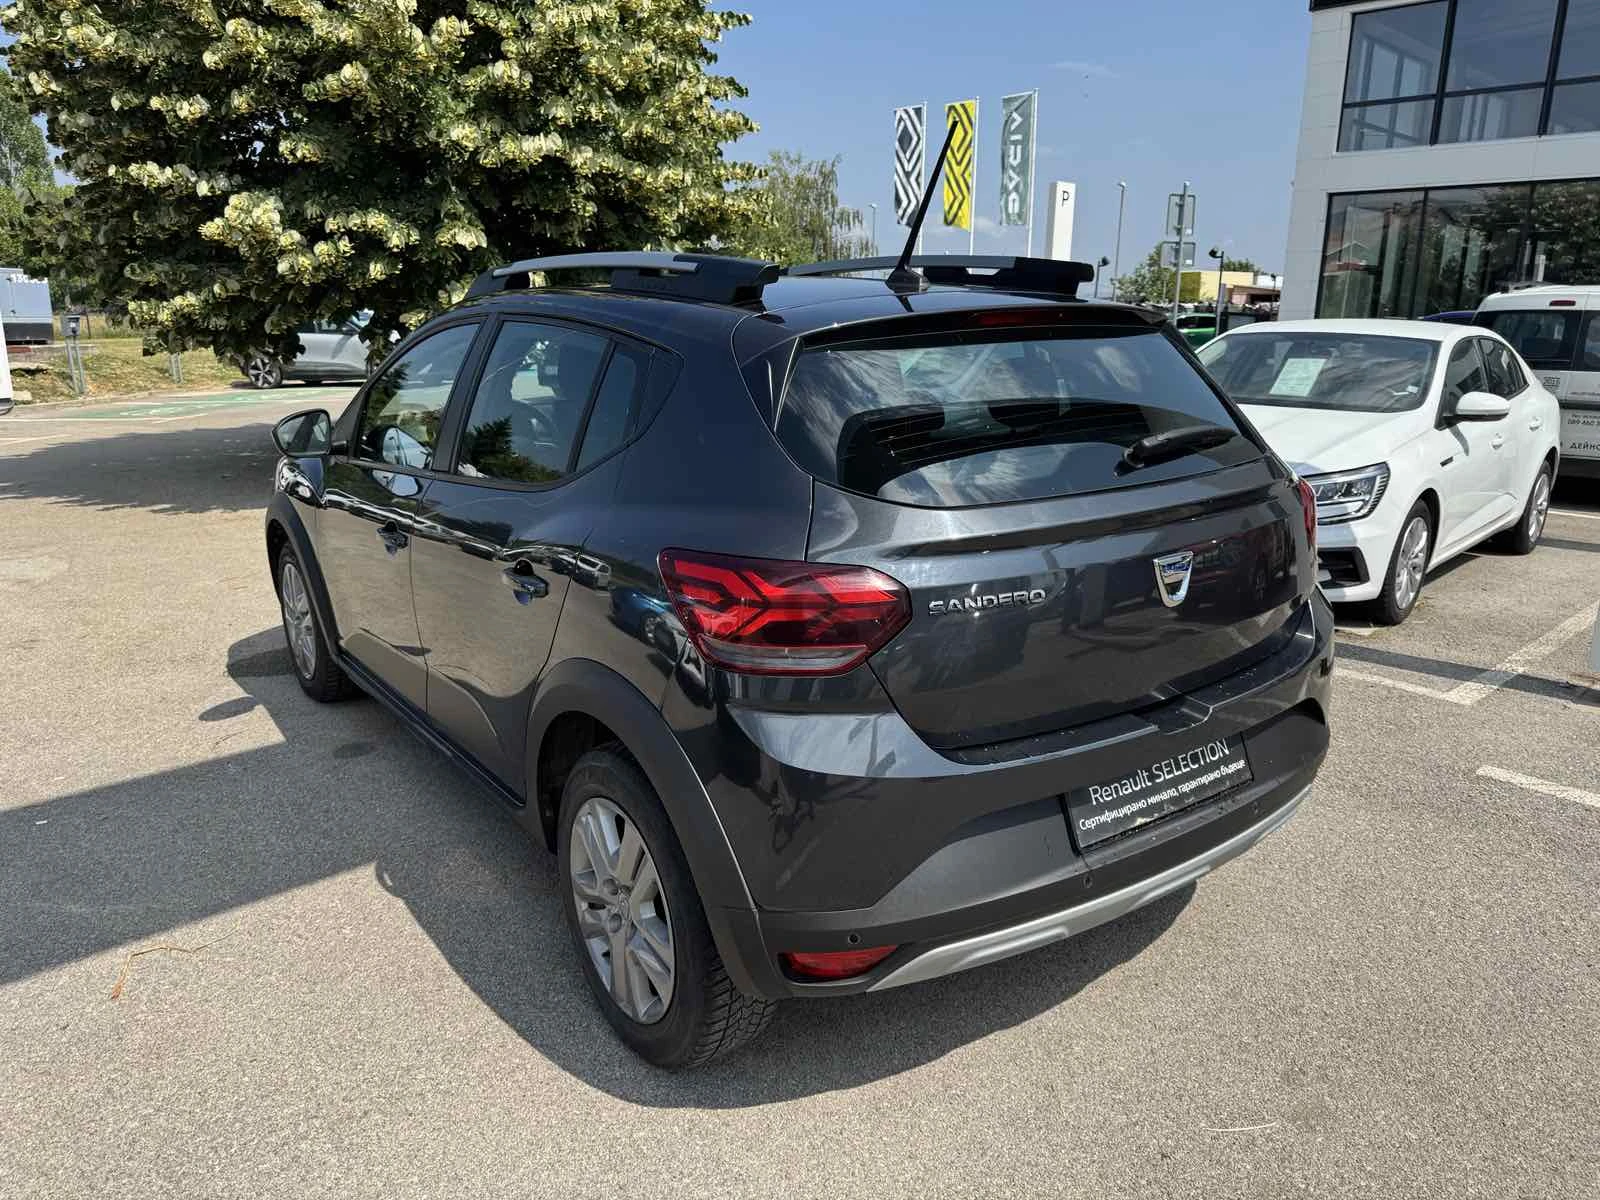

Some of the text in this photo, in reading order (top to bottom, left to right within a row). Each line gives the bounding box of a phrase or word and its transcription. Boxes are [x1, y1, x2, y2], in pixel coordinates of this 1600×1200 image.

[1061, 190, 1070, 207] P
[929, 589, 1046, 615] SANDERO
[1079, 799, 1147, 831] Сертифицирано
[1178, 770, 1221, 795] гарантирано
[1220, 758, 1246, 776] бъдеще
[1088, 738, 1230, 806] Renault SELECTION
